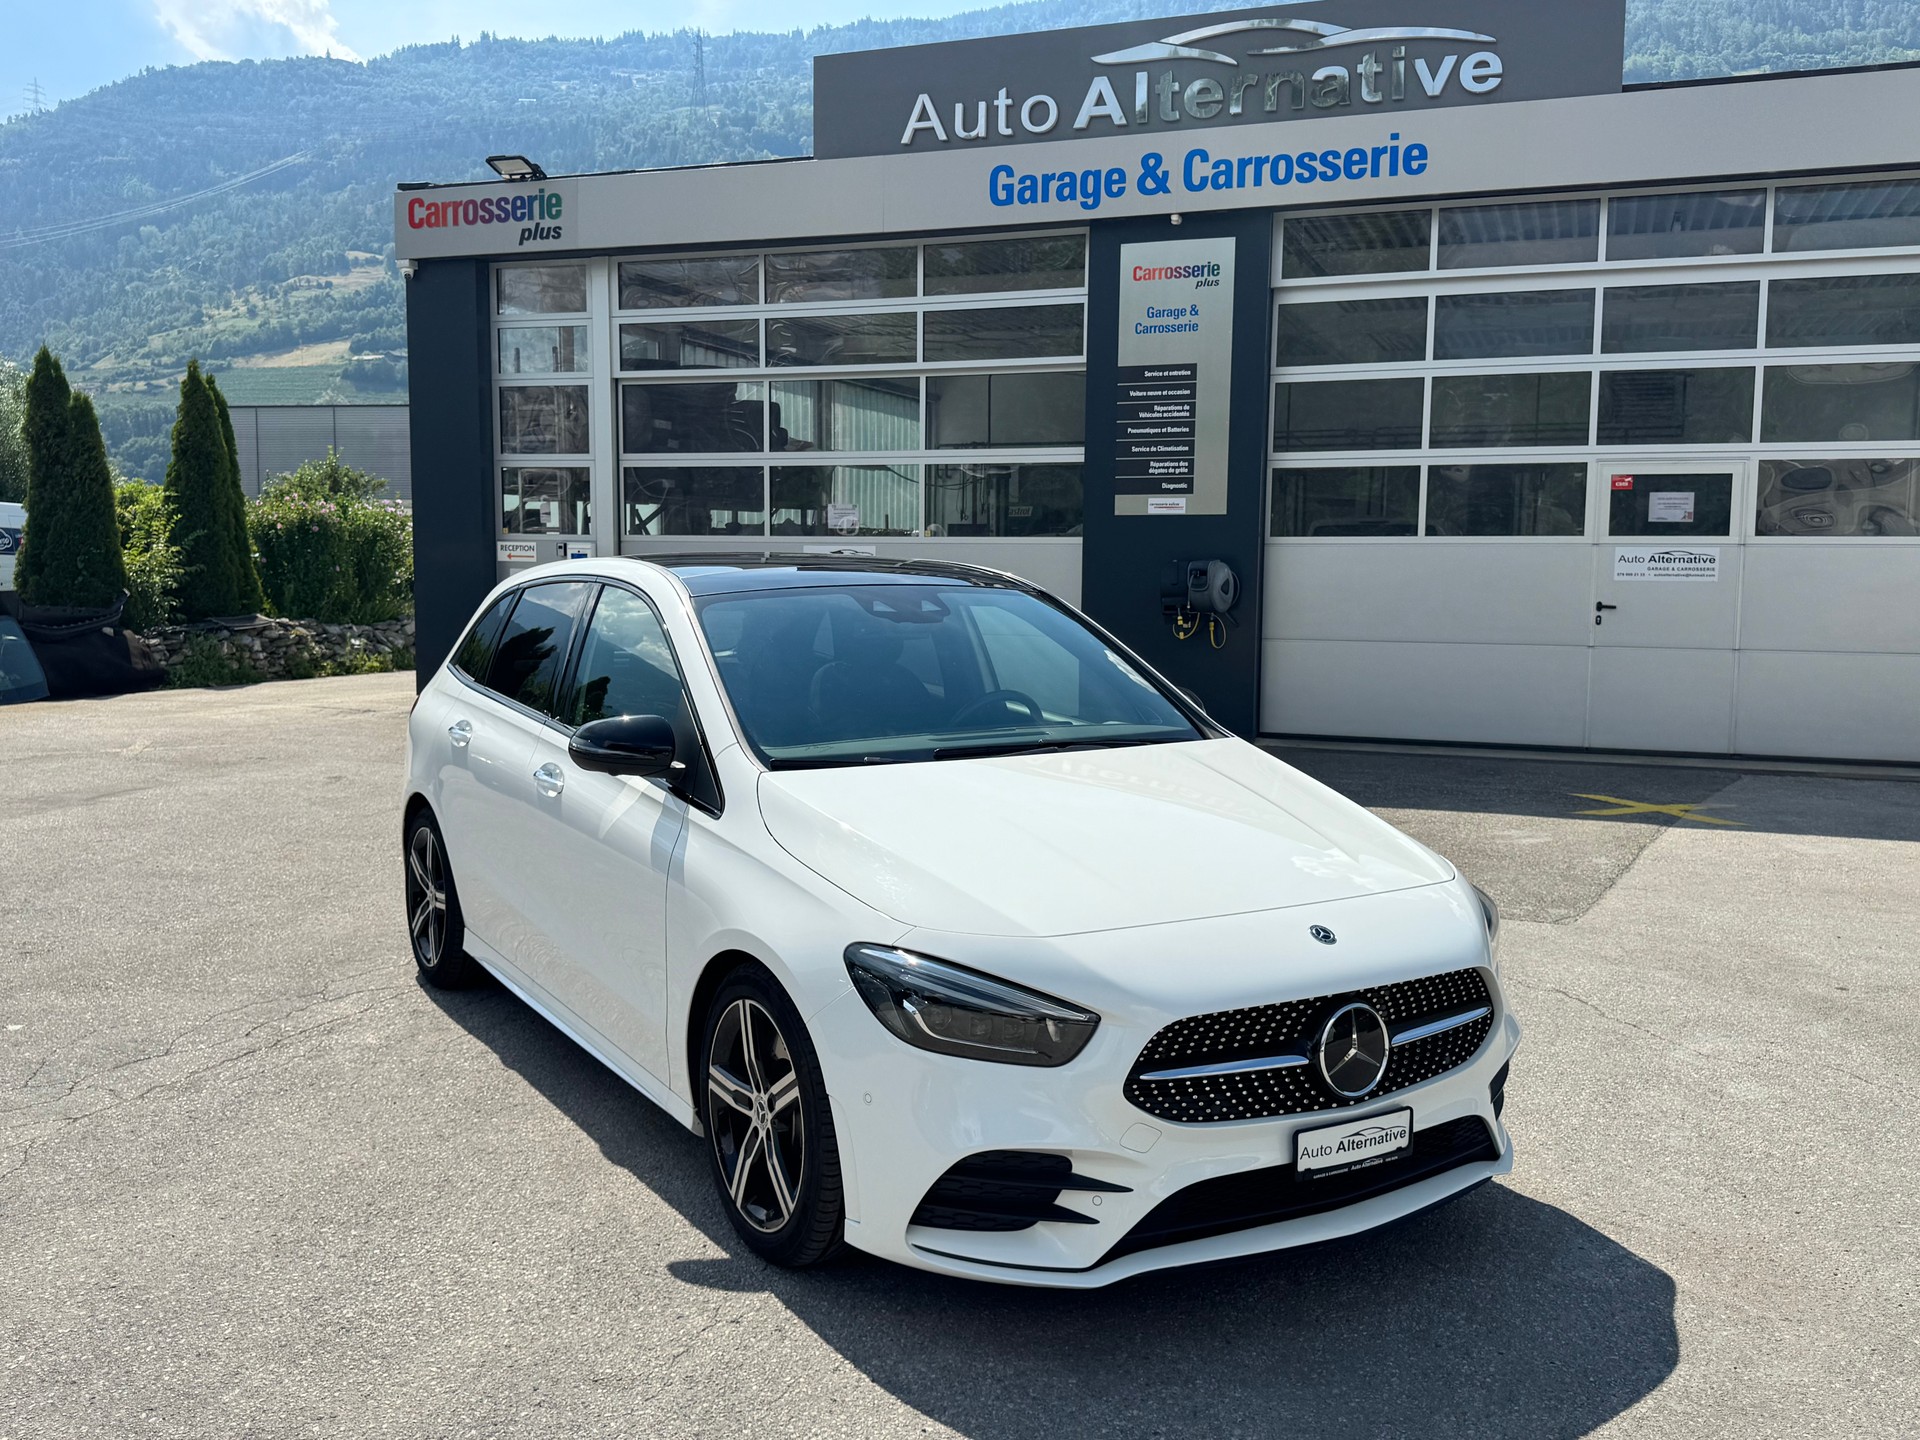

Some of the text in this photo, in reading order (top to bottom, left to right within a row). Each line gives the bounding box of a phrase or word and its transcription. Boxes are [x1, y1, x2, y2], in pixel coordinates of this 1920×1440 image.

[901, 46, 1503, 145] Auto Alternative
[989, 132, 1428, 210] Garage & Carrosserie
[408, 188, 563, 230] Carrosserie
[518, 222, 563, 246] plus
[1132, 261, 1221, 282] Carrosserie
[1195, 278, 1220, 289] plus
[1146, 304, 1199, 320] Garage &
[1135, 320, 1199, 335] Carrosserie
[1153, 404, 1182, 412] Réparations
[1161, 482, 1188, 490] Diagnostic
[500, 544, 535, 552] RECEPTION
[1618, 554, 1716, 564] Auto Alternative
[1300, 1129, 1407, 1160] Auto Alternative
